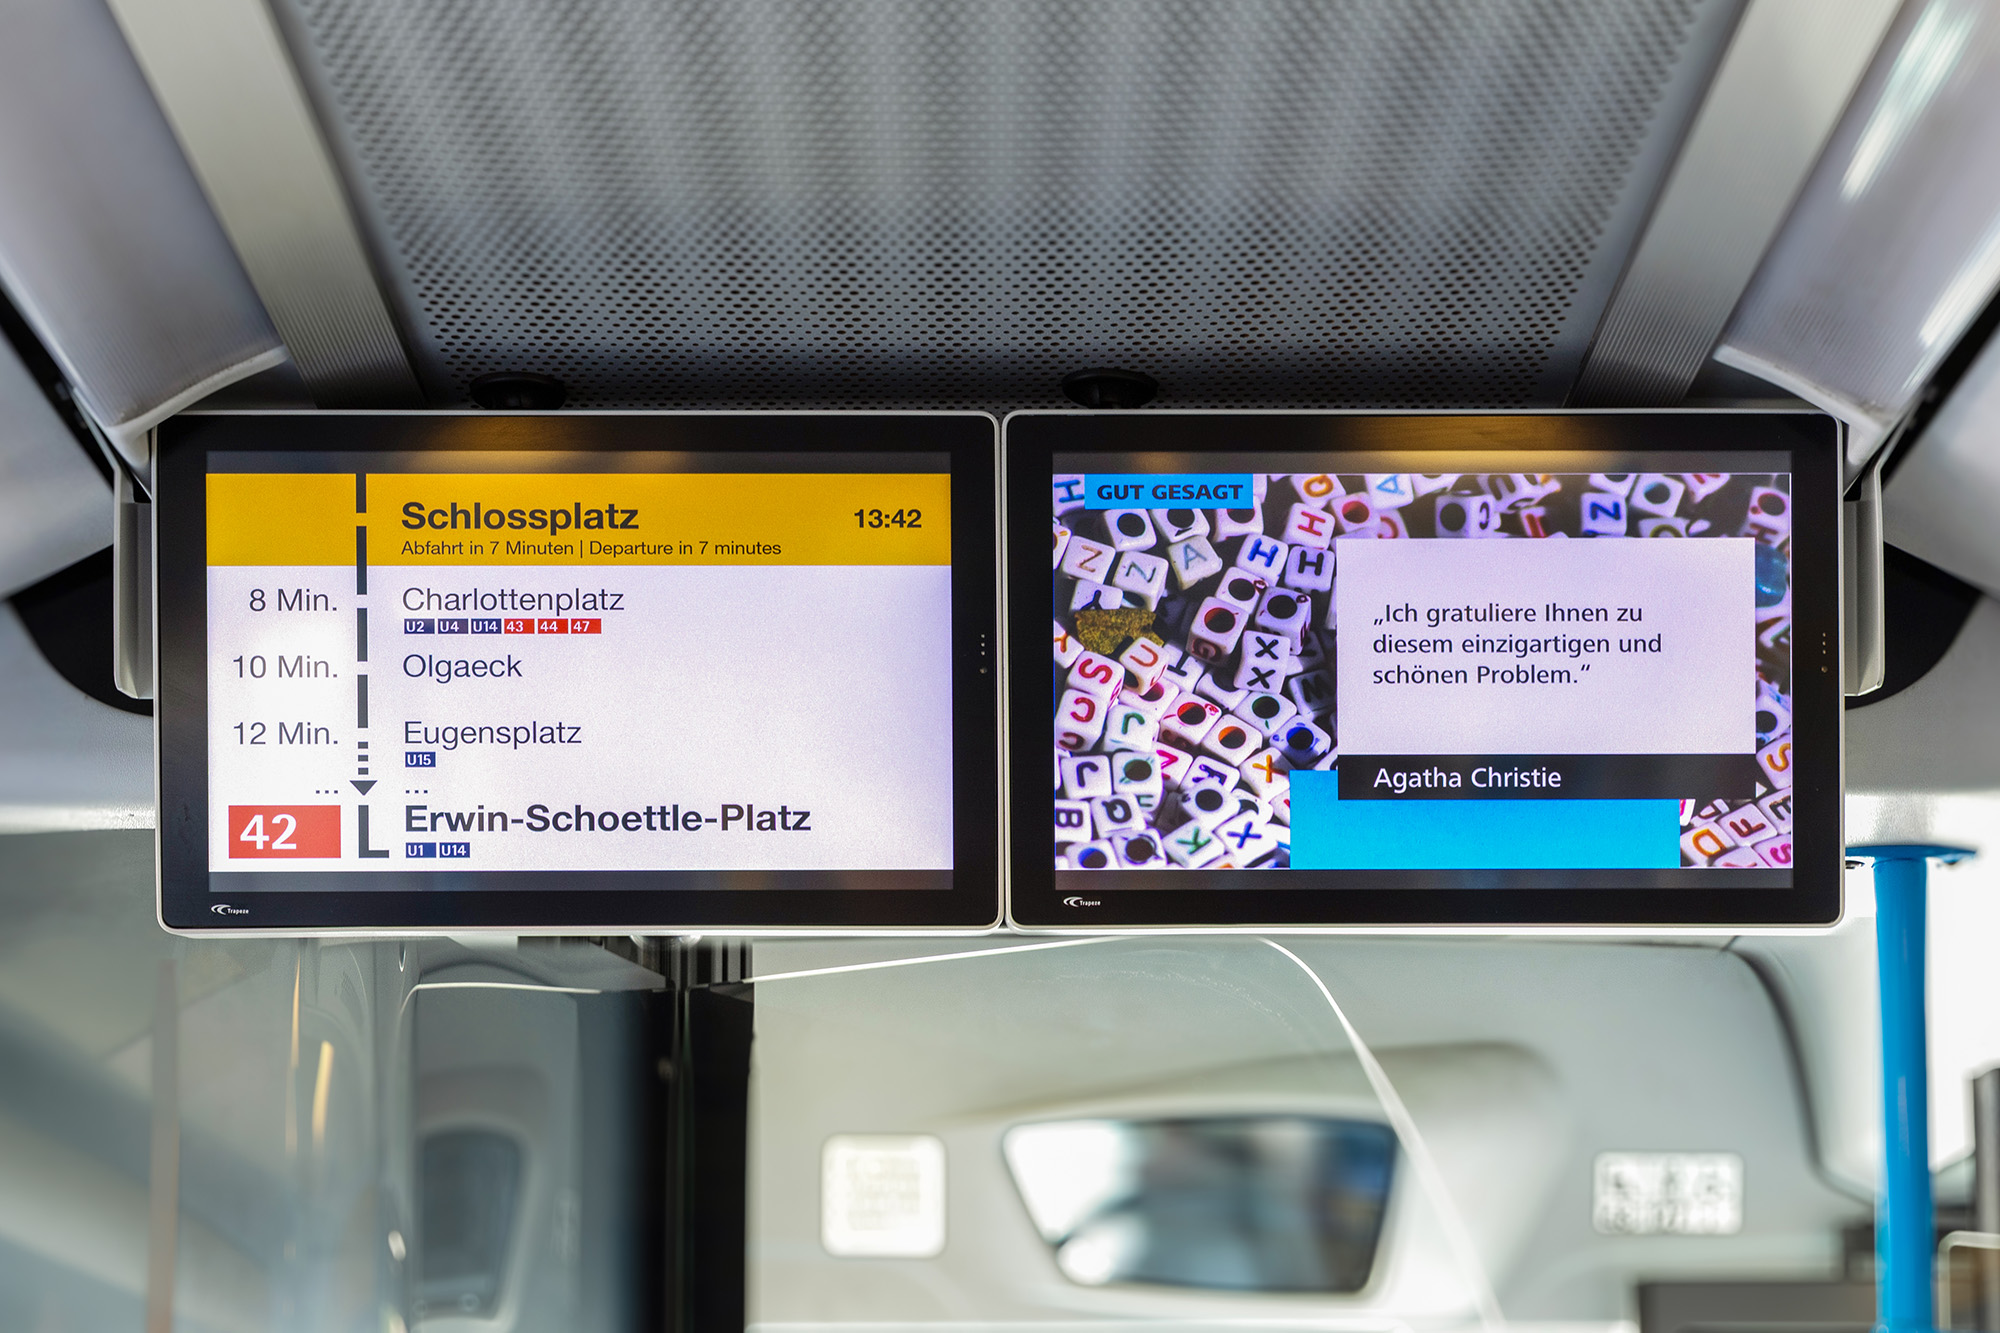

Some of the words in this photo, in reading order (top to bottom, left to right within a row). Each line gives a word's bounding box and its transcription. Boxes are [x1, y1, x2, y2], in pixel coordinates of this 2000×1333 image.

[1097, 484, 1145, 500] GUT
[1151, 484, 1244, 500] GESAGT
[401, 501, 640, 537] Schlossplatz
[854, 508, 922, 529] 13:42
[1297, 510, 1326, 537] H
[401, 540, 464, 555] Abfahrt
[469, 540, 484, 555] in
[490, 541, 500, 555] 7
[506, 540, 574, 555] Minuten
[589, 540, 673, 558] Departure
[679, 540, 693, 555] in
[699, 540, 709, 555] 7
[714, 540, 782, 555] minutes
[1183, 543, 1207, 570] A
[1248, 538, 1279, 567] H
[1297, 549, 1325, 577] H
[249, 588, 266, 612] 8
[277, 588, 337, 612] Min.
[402, 587, 625, 617] Charlottenplatz
[406, 620, 425, 633] U2
[439, 620, 460, 633] U4
[473, 620, 498, 633] U14
[506, 620, 524, 632] 43
[540, 620, 558, 632] 44
[573, 620, 590, 632] 47
[1426, 602, 1537, 628] gratuliere
[1545, 602, 1608, 622] Ihnen
[1616, 608, 1642, 622] zu
[1255, 636, 1279, 660] X
[1373, 633, 1453, 654] diesem
[1461, 634, 1610, 659] einzigartigen
[1619, 633, 1662, 653] und
[233, 655, 266, 679] 10
[278, 655, 338, 678] Min.
[403, 654, 523, 684] Olgaeck
[1078, 658, 1113, 684] S
[1246, 666, 1276, 689] X
[1373, 664, 1468, 684] schönen
[233, 721, 266, 745] 12
[278, 721, 338, 745] Min.
[404, 720, 582, 751] Eugensplatz
[407, 753, 432, 766] U15
[1373, 766, 1462, 794] Agatha
[1471, 766, 1562, 788] Christie
[405, 804, 812, 832] Erwin-Schoettle-Platz
[1729, 818, 1766, 838] F
[239, 813, 297, 850] 42
[1227, 821, 1262, 849] X
[407, 844, 424, 857] U1
[441, 844, 467, 856] U14
